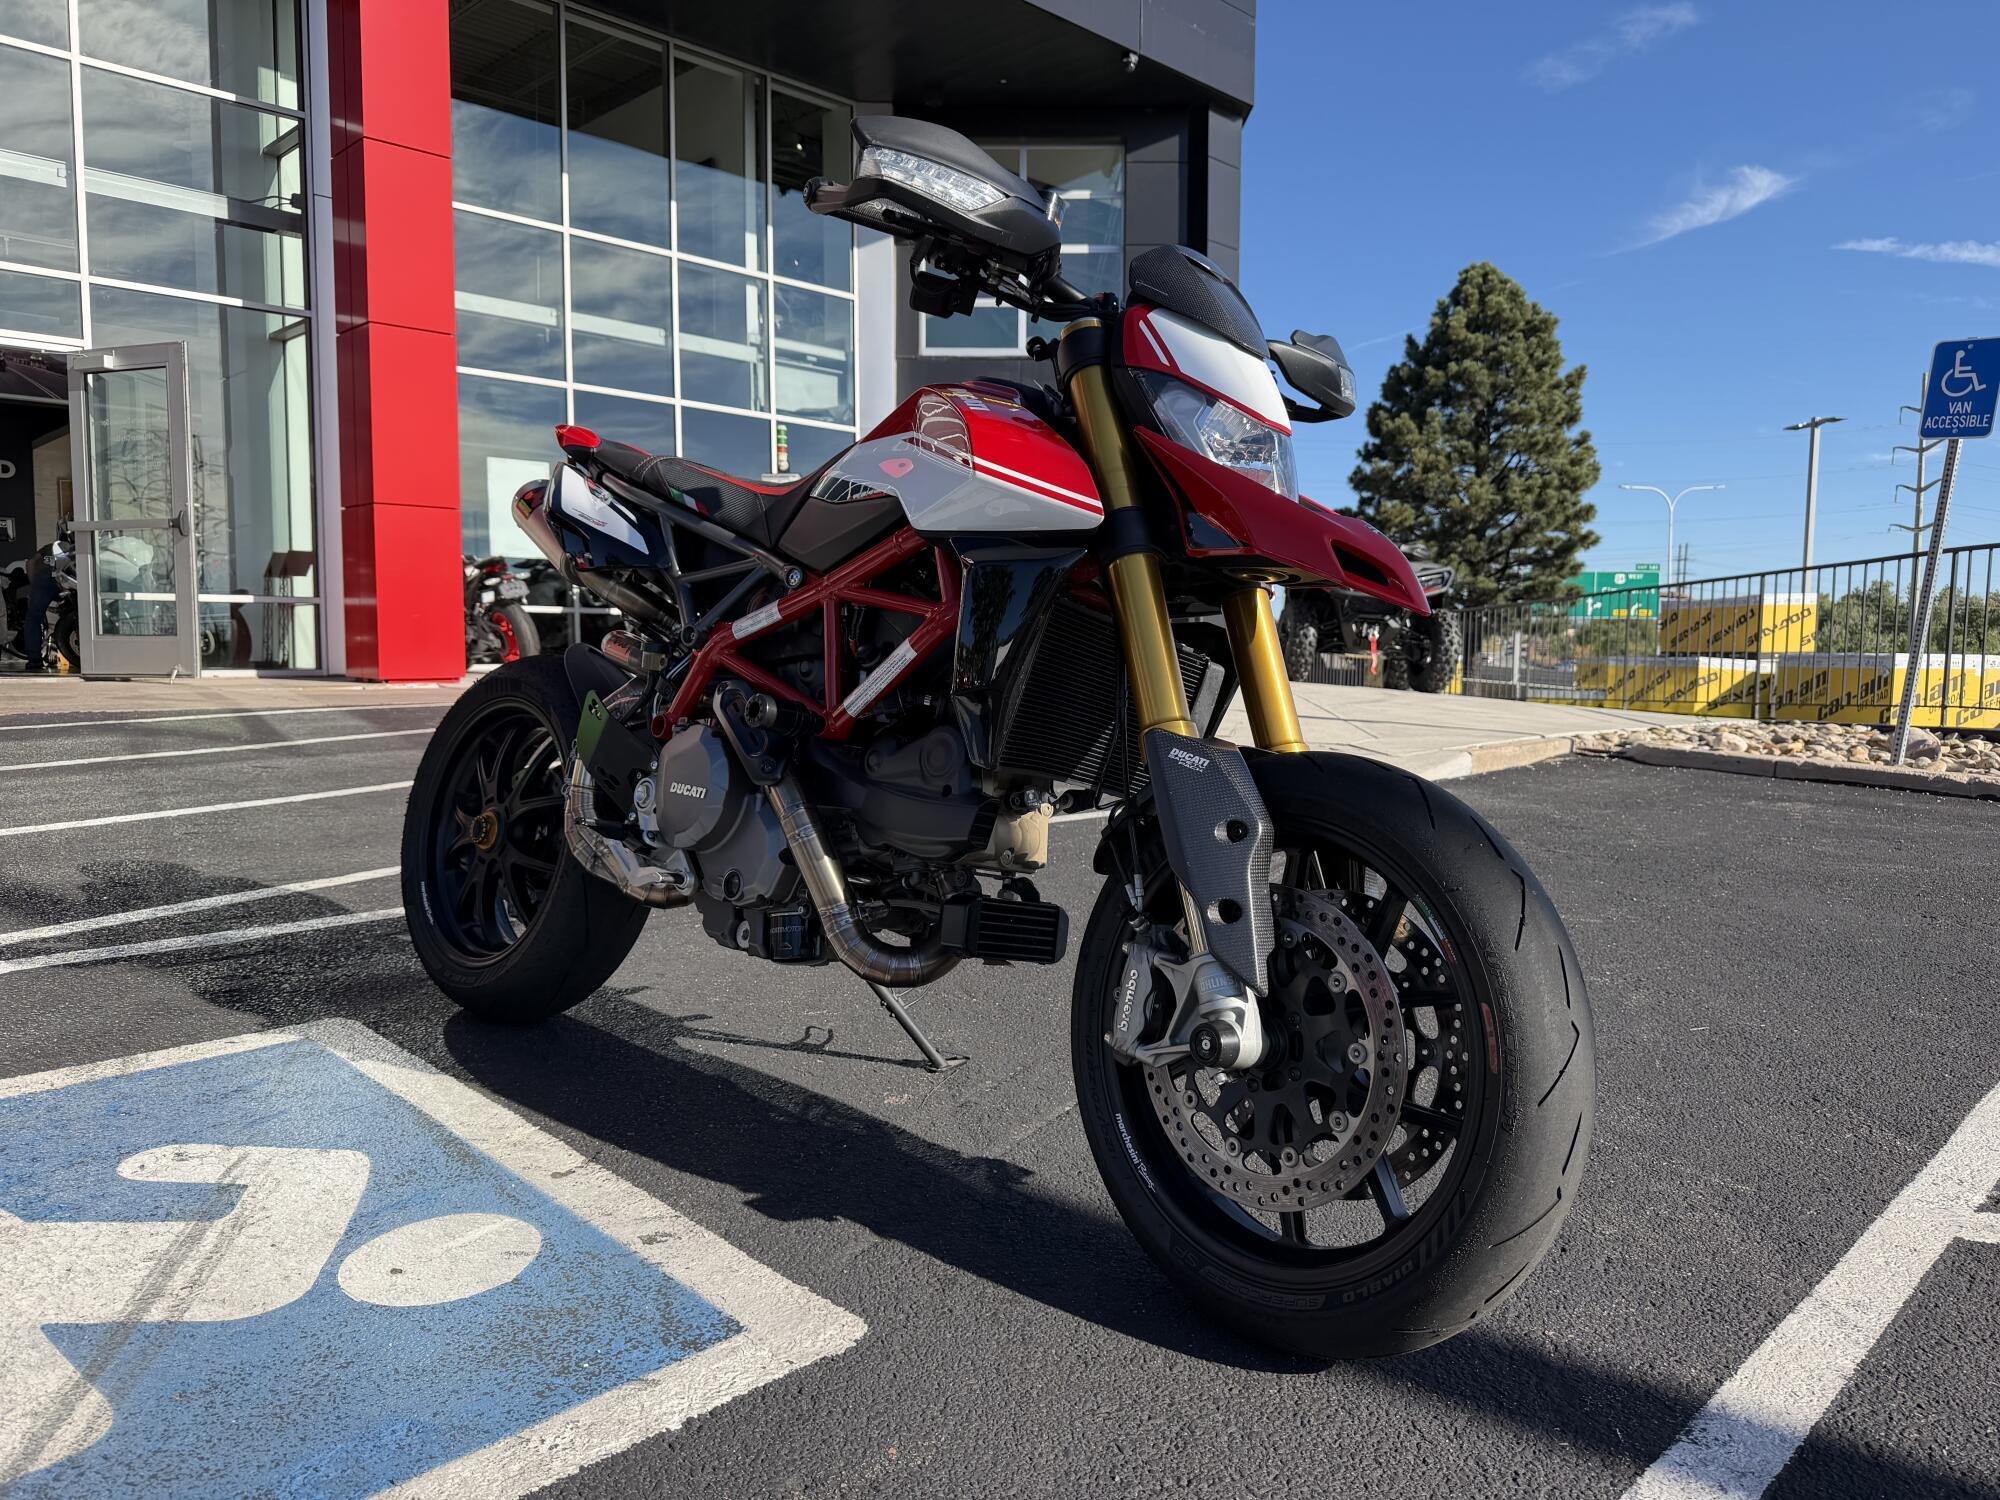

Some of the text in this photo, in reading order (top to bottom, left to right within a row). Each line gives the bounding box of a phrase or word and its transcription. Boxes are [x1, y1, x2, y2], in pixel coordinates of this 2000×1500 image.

[1949, 401, 1972, 414] VAN
[1924, 414, 1991, 429] ACCESSIBLE
[1170, 748, 1210, 767] DUCATI
[670, 781, 707, 799] DUCATI
[1118, 969, 1139, 1032] brembo
[1115, 1113, 1141, 1164] marchesini
[1343, 1262, 1414, 1304] DIABLO
